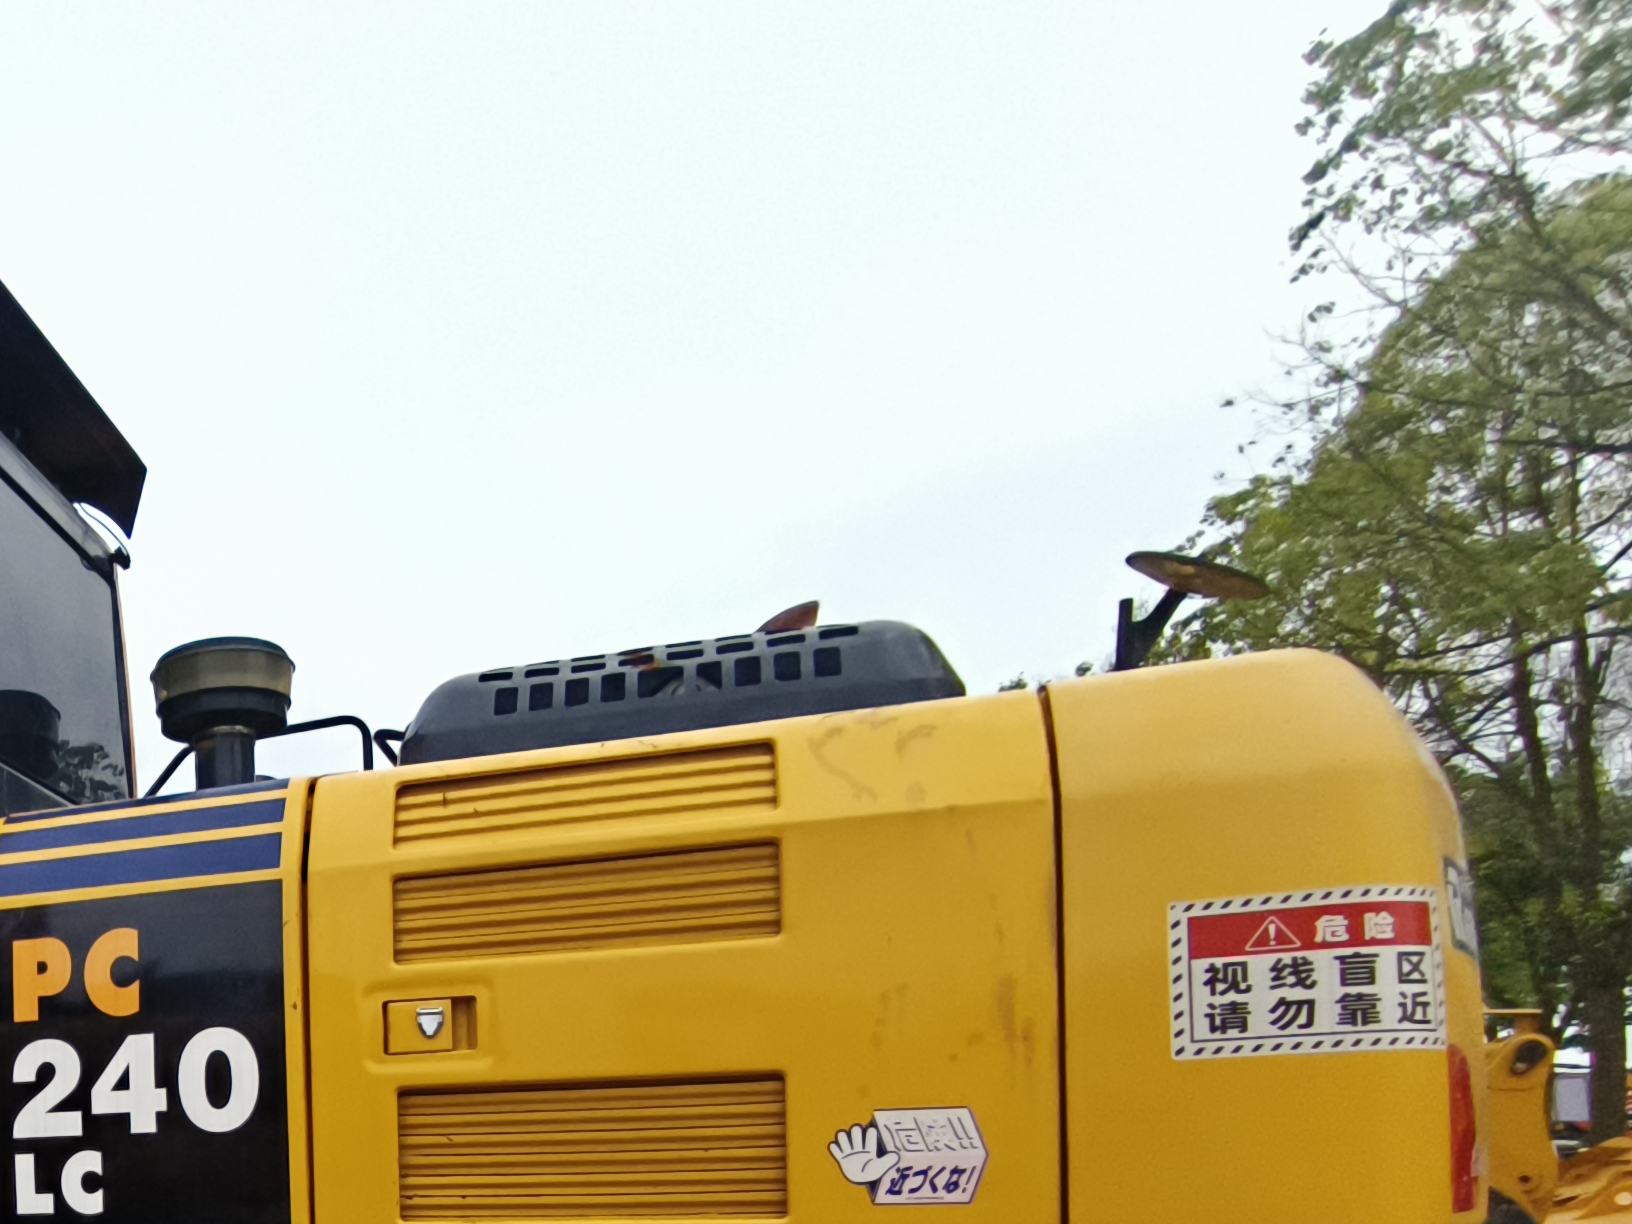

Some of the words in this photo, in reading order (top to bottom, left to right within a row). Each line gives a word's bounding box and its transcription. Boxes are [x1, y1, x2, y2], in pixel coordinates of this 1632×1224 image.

[1314, 911, 1395, 943] 危险
[12, 927, 140, 1023] PC
[1203, 951, 1428, 997] 视线盲区
[1204, 991, 1432, 1035] 请勿靠近
[12, 1026, 260, 1139] 240
[14, 1149, 104, 1215] LC
